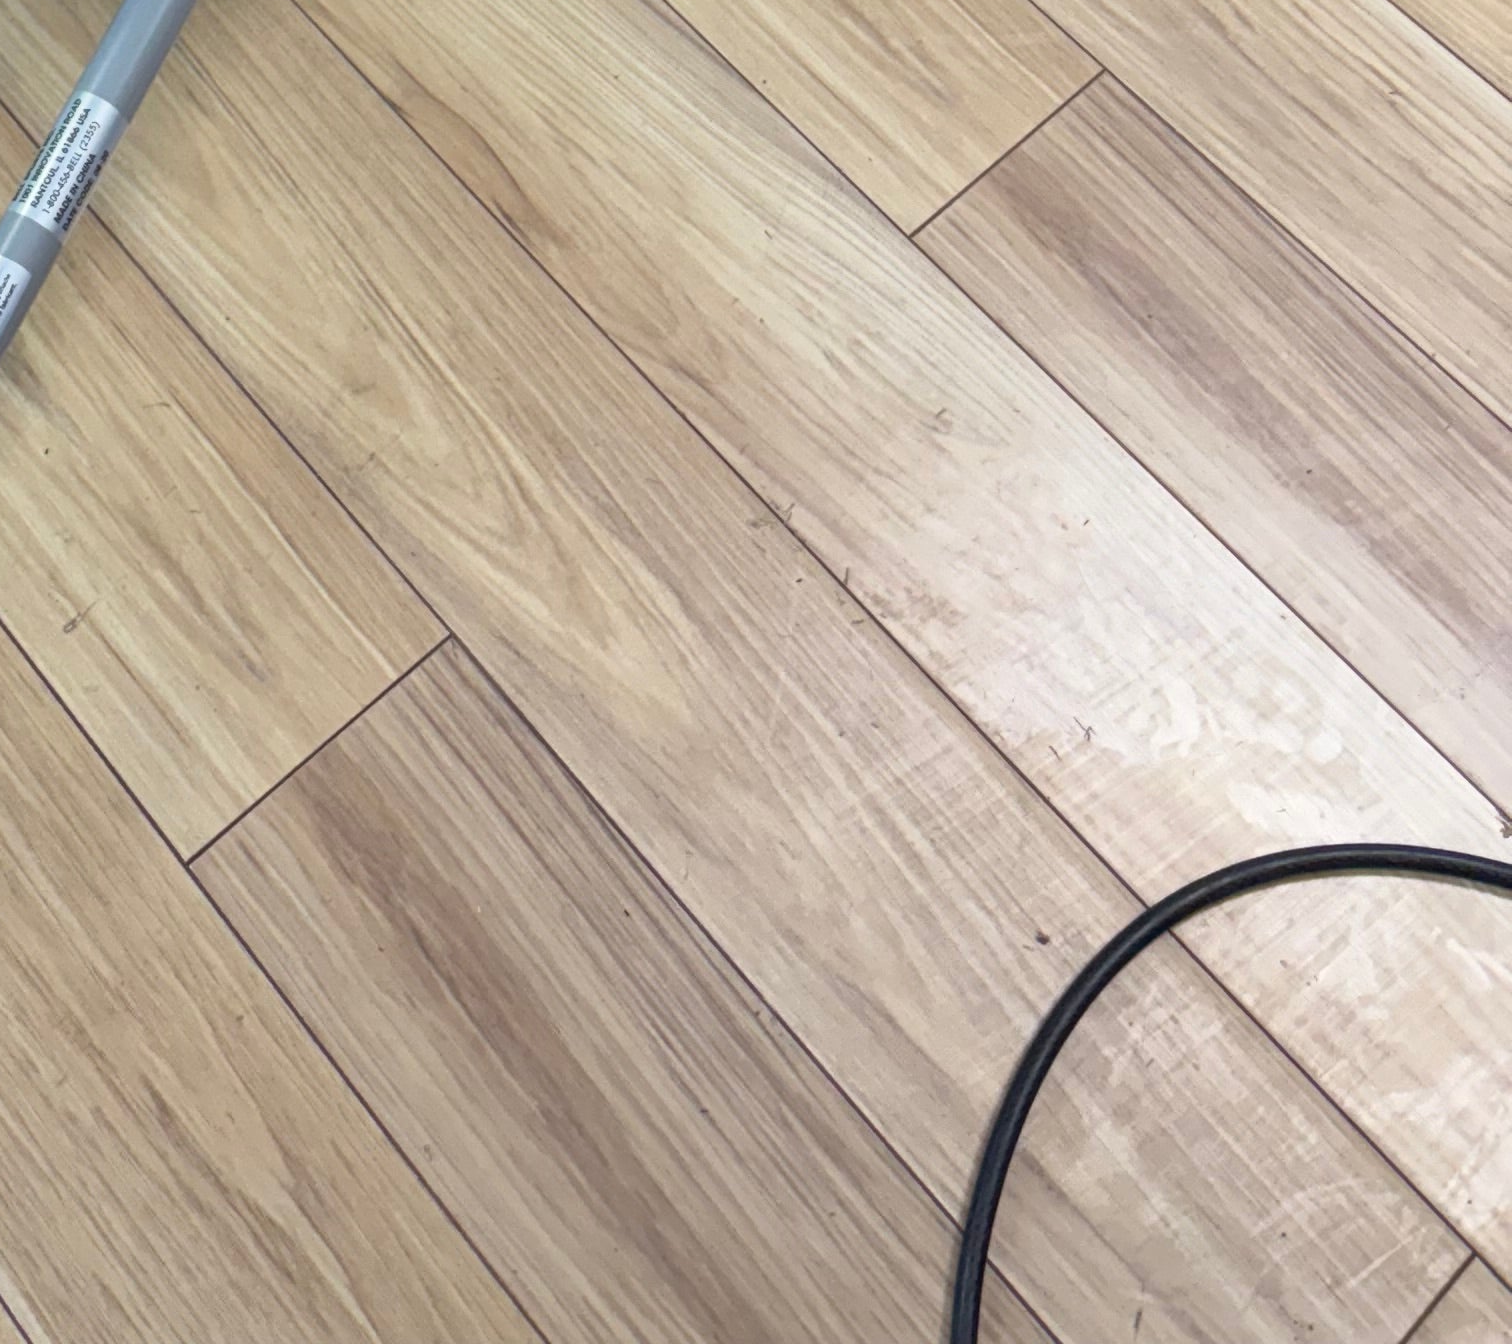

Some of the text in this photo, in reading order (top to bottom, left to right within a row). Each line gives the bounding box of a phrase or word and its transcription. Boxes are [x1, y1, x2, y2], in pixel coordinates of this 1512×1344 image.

[63, 98, 81, 125] ROAD
[78, 107, 90, 125] USA
[54, 154, 96, 223] MADE IN CHINA
